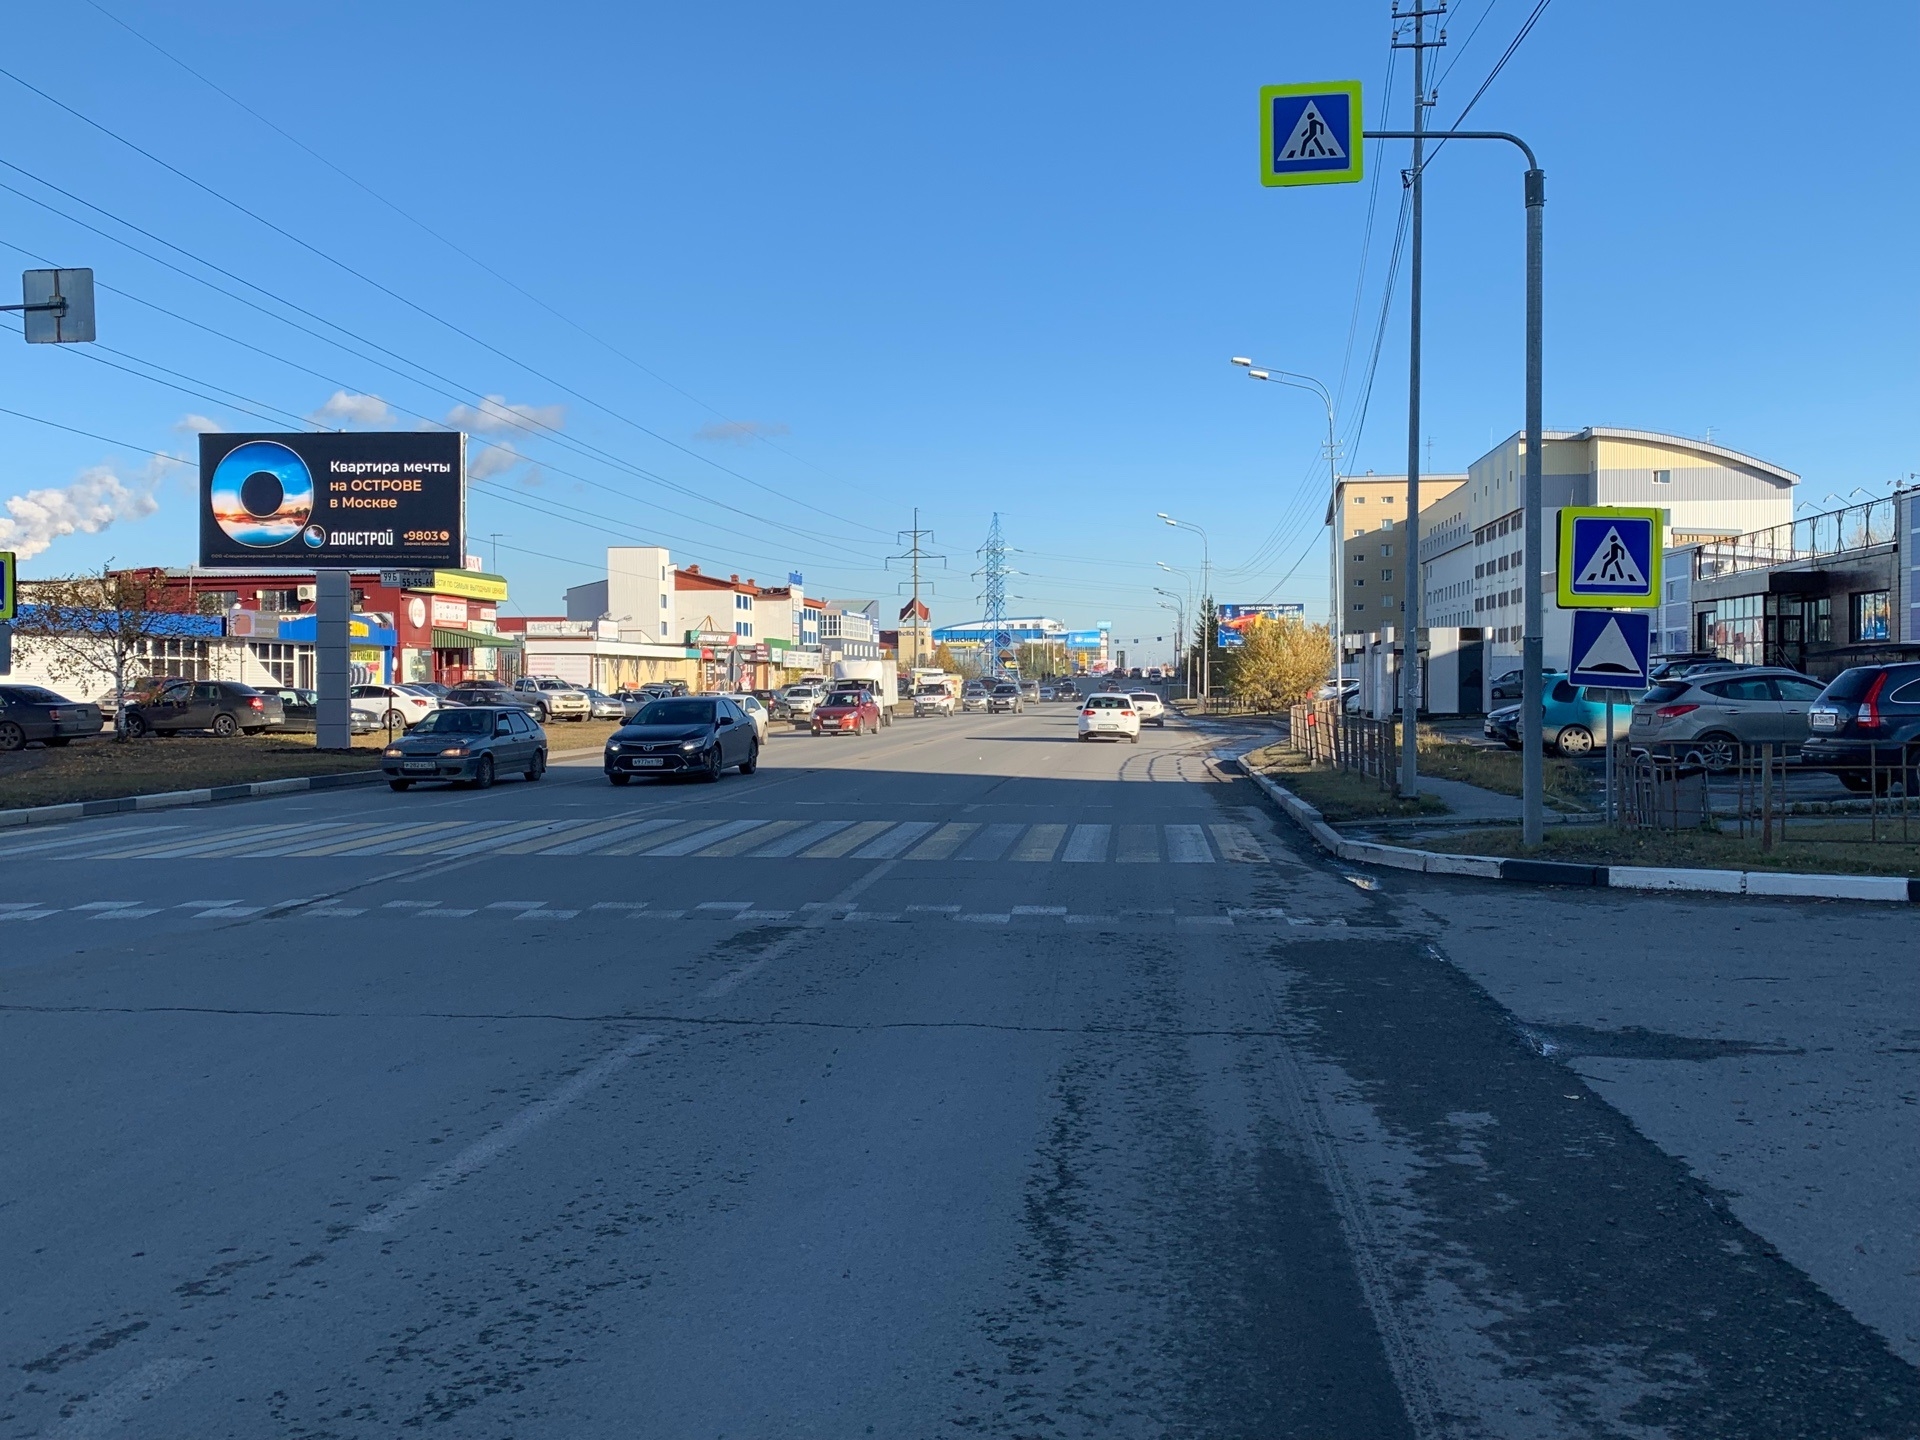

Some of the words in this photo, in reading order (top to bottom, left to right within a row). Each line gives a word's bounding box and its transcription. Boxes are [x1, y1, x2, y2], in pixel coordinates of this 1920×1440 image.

[330, 461, 400, 475] Квартира
[403, 462, 451, 473] мечты
[329, 481, 347, 491] на
[350, 479, 422, 491] ОСТРОВЕ
[329, 498, 338, 508] в
[342, 496, 398, 508] Москве
[329, 529, 394, 546] ДОНСТРОЙ
[402, 578, 434, 588] 55-55-66
[453, 581, 469, 590] самым
[469, 583, 491, 593] выгодным
